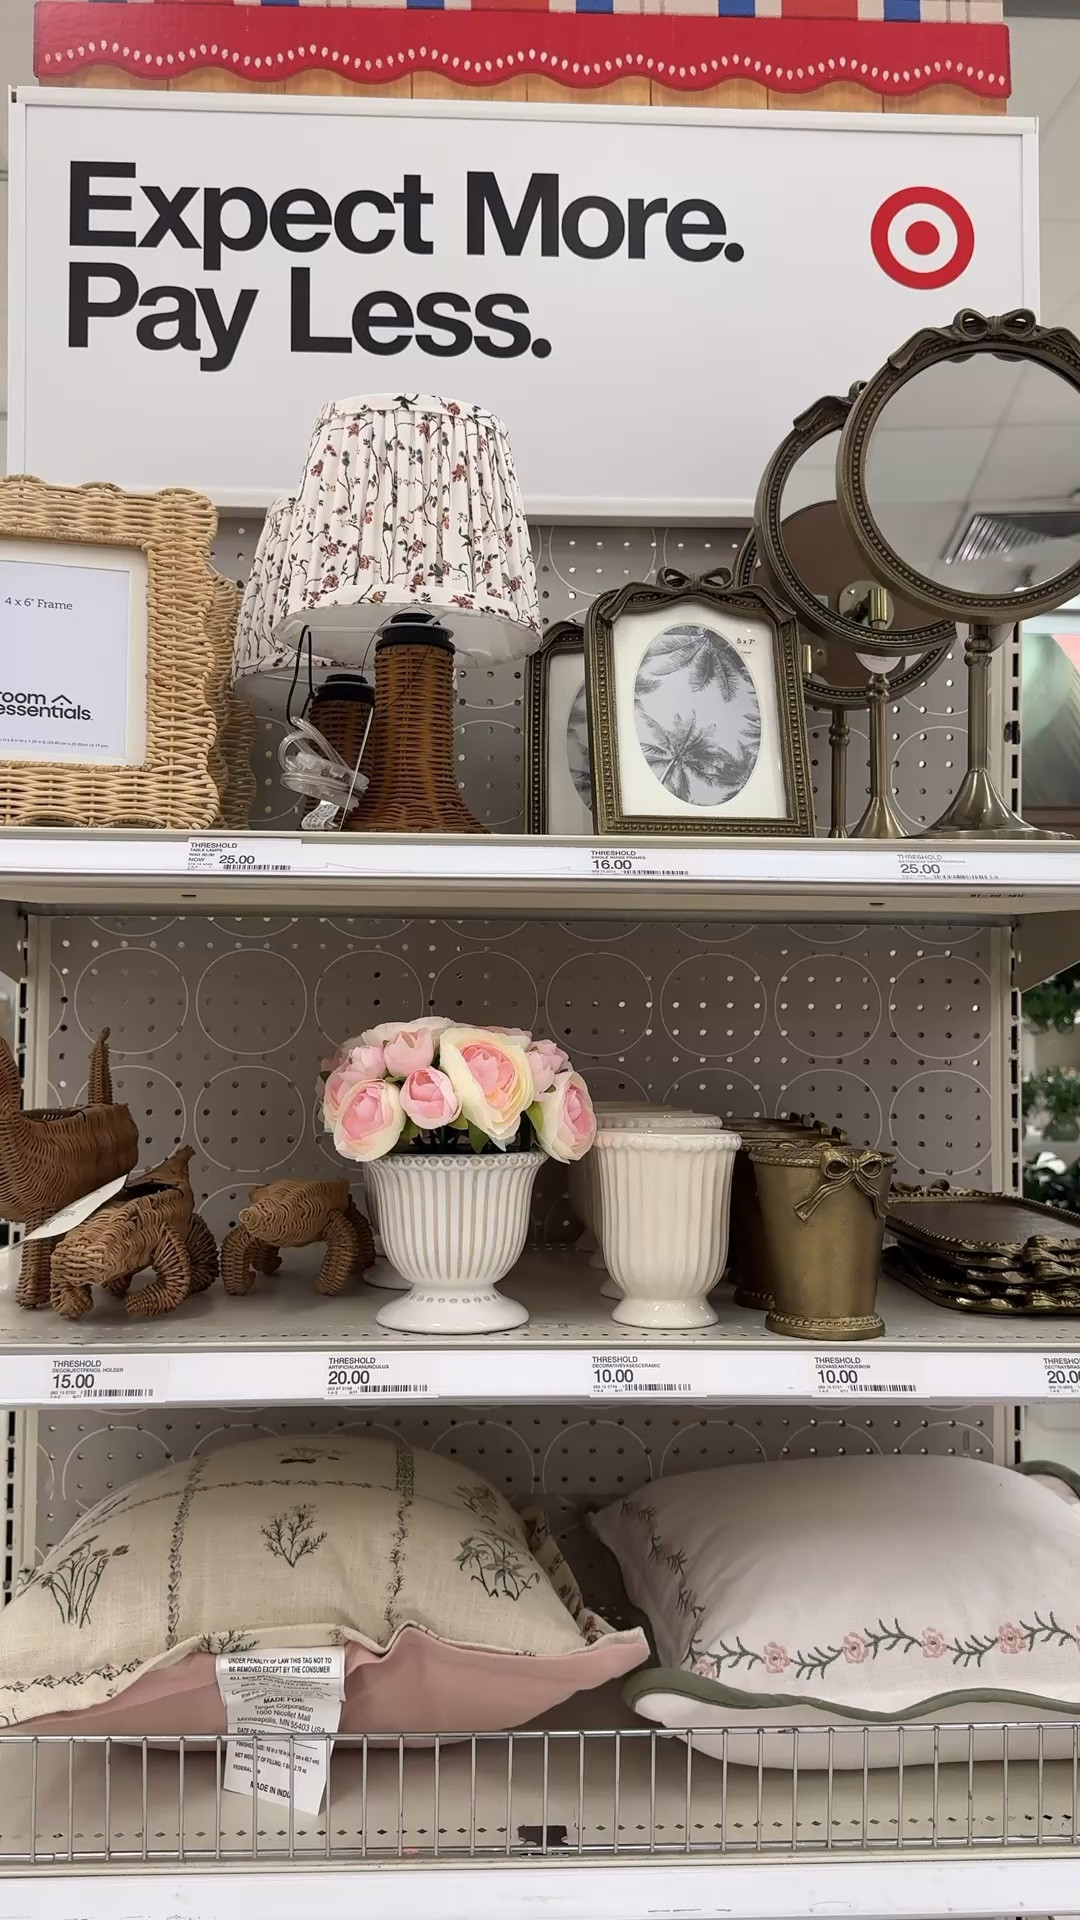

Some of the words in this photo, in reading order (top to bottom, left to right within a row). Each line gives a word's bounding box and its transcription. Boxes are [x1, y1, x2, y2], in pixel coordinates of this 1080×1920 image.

[69, 160, 434, 271] Expect
[466, 170, 745, 263] More.
[68, 261, 260, 372] Pay
[290, 266, 552, 359] Less.
[5, 597, 12, 605] 4
[37, 599, 73, 610] Frame
[219, 855, 255, 865] 25.00
[592, 859, 632, 870] 16.00
[900, 863, 941, 874] 25.00
[53, 1360, 102, 1368] THRESHOLD
[328, 1357, 376, 1365] THRESHOLD
[592, 1355, 639, 1363] THRESHOLD
[1043, 1357, 1080, 1365] THRESHO
[53, 1373, 95, 1389] 15.00
[328, 1370, 370, 1385] 20.00
[593, 1369, 634, 1383] 10.00
[818, 1370, 858, 1384] 10.00
[246, 1657, 269, 1665] PENALTY
[262, 1666, 282, 1674] EXCEPT
[275, 1703, 314, 1713] Corporation
[273, 1709, 297, 1719] Nicollet
[297, 1711, 312, 1722] Mall
[279, 1718, 290, 1727] MN
[290, 1721, 310, 1731] 55403
[311, 1726, 326, 1734] USA
[269, 1786, 277, 1794] IN
